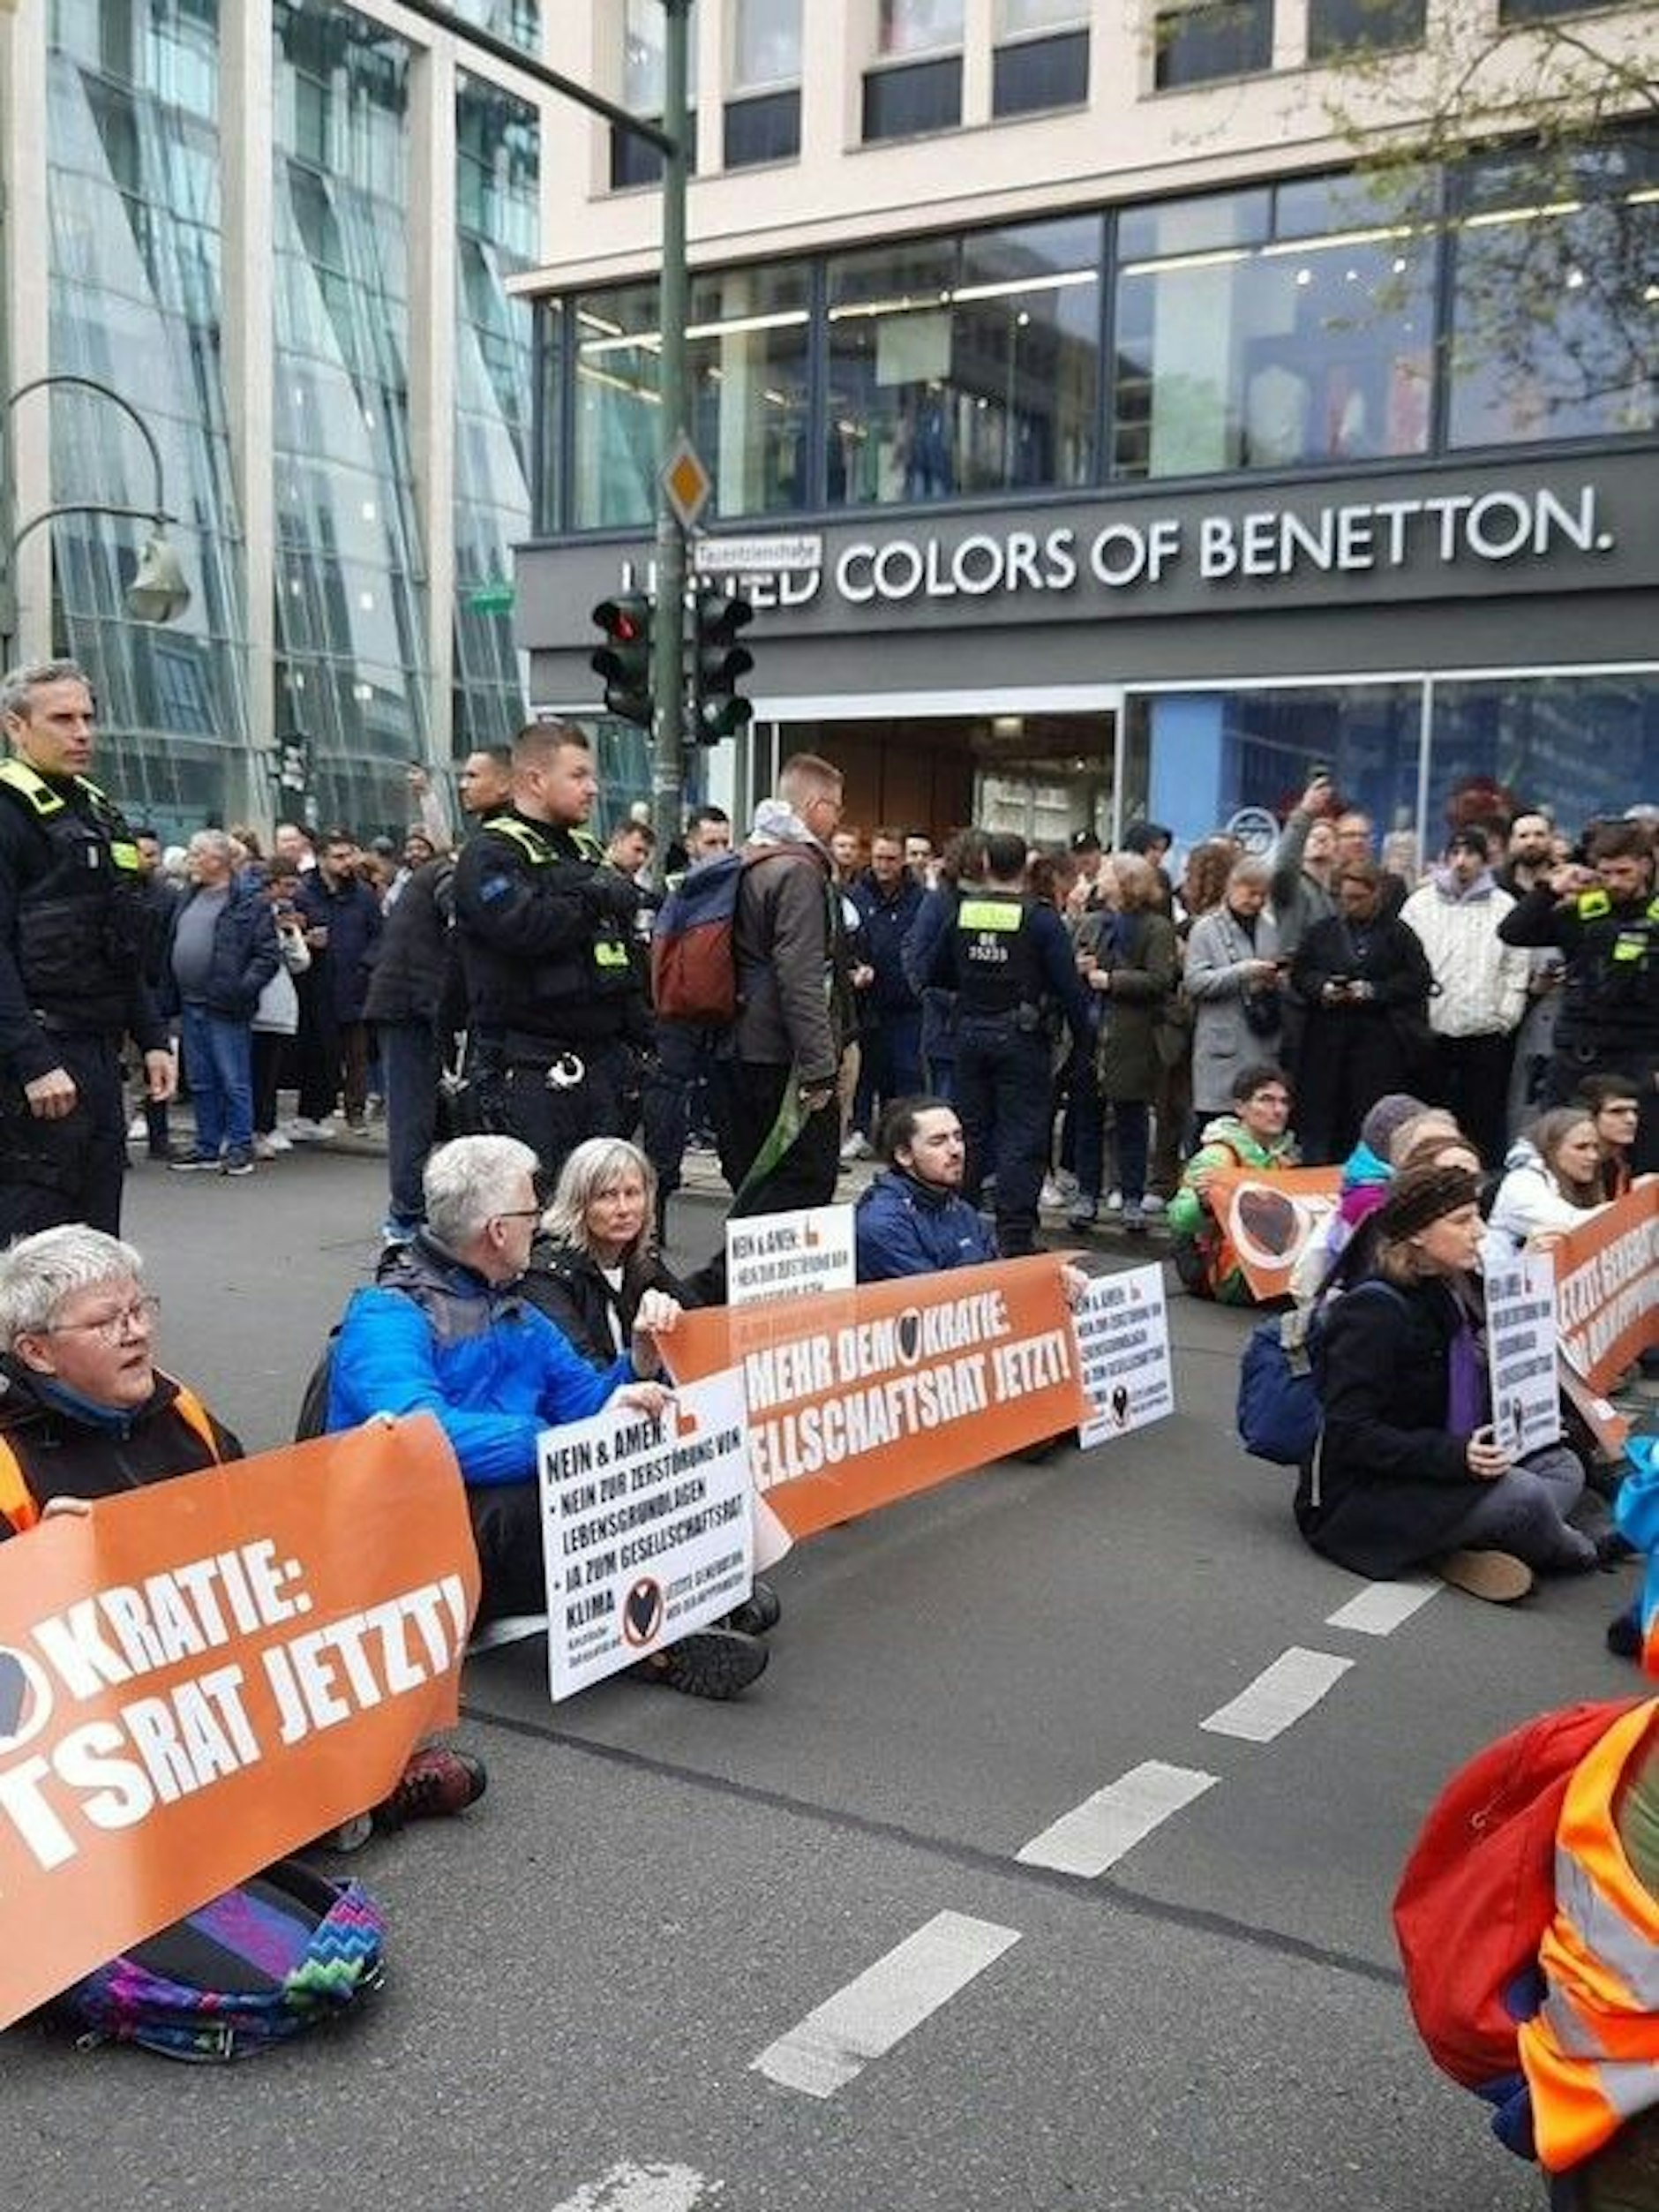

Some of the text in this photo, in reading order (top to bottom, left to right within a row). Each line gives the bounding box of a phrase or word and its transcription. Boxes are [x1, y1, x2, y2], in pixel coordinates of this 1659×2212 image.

[836, 528, 1077, 602] COLORS
[1091, 519, 1181, 585] OF
[1199, 486, 1614, 578] BENETTON.
[746, 1335, 834, 1412] MEHR
[993, 1329, 1071, 1401] JETZT!
[546, 1416, 667, 1485] NEIN & AMEN:
[560, 1485, 596, 1519] NEIN
[601, 1474, 627, 1503] ZUR
[717, 1426, 742, 1456] VON
[563, 1478, 707, 1555] LEBENSGRUNDLAGEN
[567, 1493, 744, 1594] JA ZUM GESELLSCHAFTSRAT
[566, 1590, 615, 1632] KLIMA
[263, 1574, 468, 1745] JETZT!
